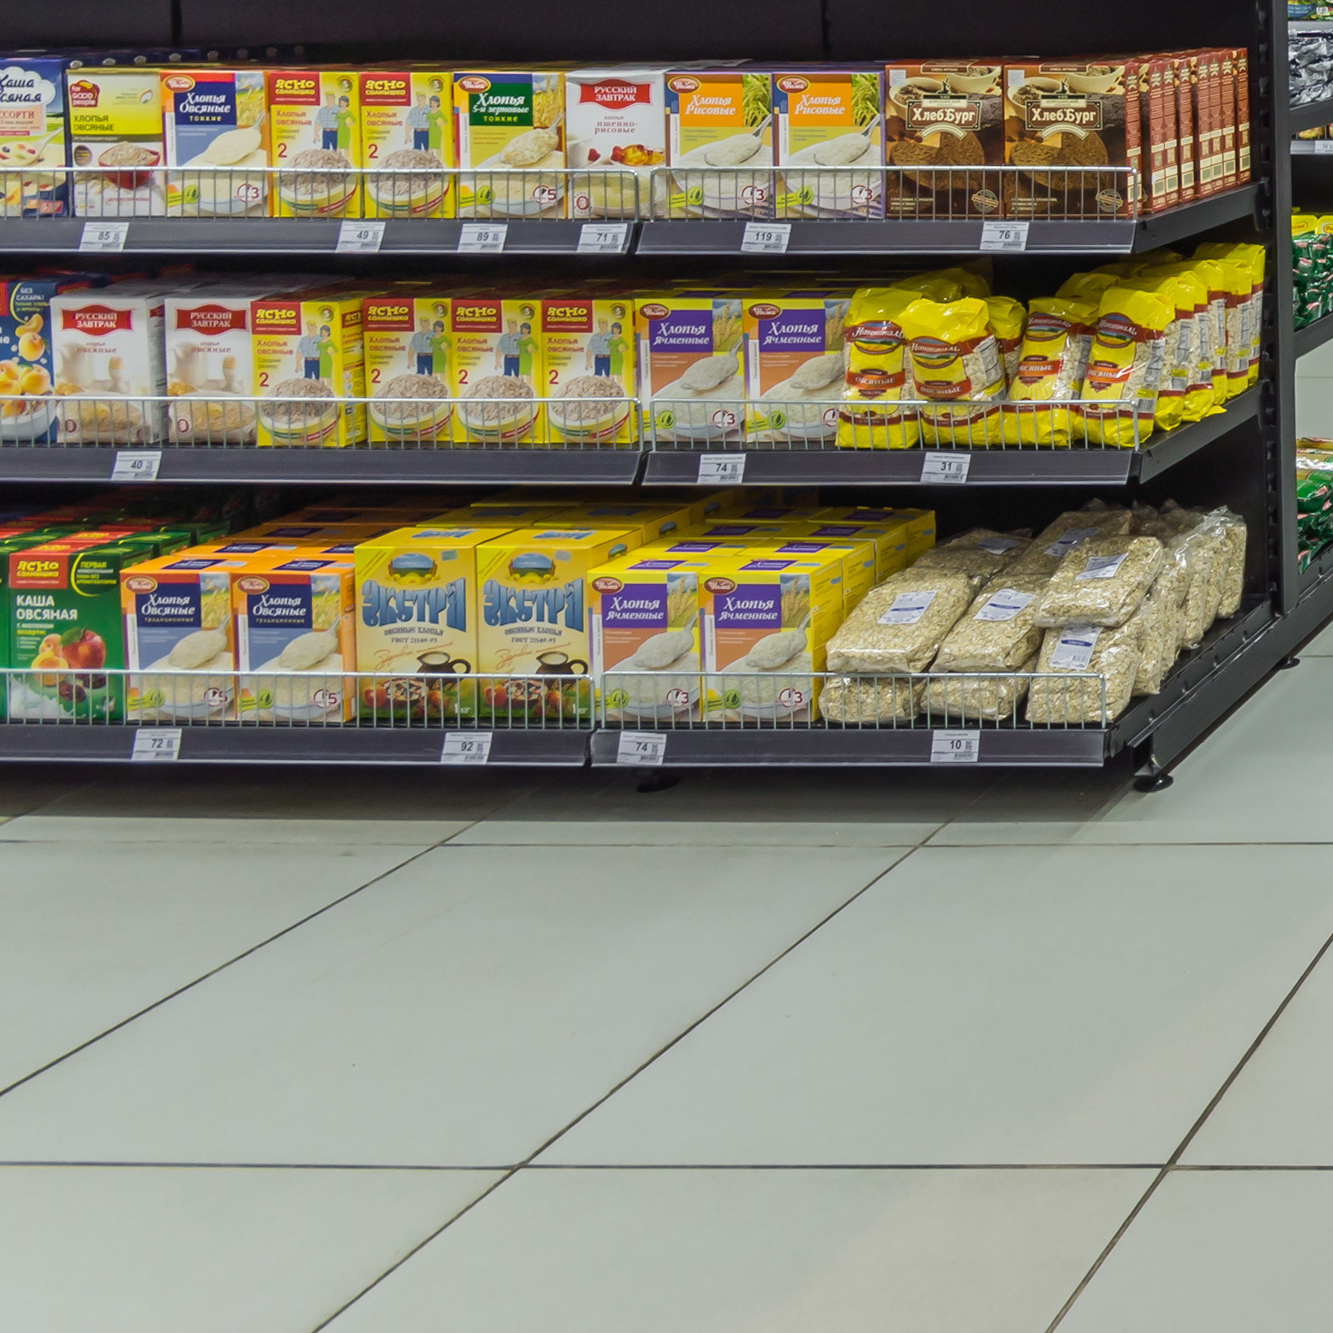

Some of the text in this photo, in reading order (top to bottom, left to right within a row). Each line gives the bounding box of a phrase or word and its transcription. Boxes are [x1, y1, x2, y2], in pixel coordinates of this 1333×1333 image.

[692, 94, 731, 107] Хлопья
[754, 232, 772, 242] 119
[657, 322, 706, 336] Хлопья
[654, 334, 709, 346] Ячменные
[16, 595, 54, 607] КАША
[147, 594, 190, 607] Хлопья
[723, 596, 773, 610] Хлопья
[16, 608, 78, 620] ОВСЯНАЯ
[141, 604, 196, 616] Овсяные
[720, 608, 778, 621] Ячменные
[460, 742, 474, 750] 92
[950, 740, 961, 750] 10
